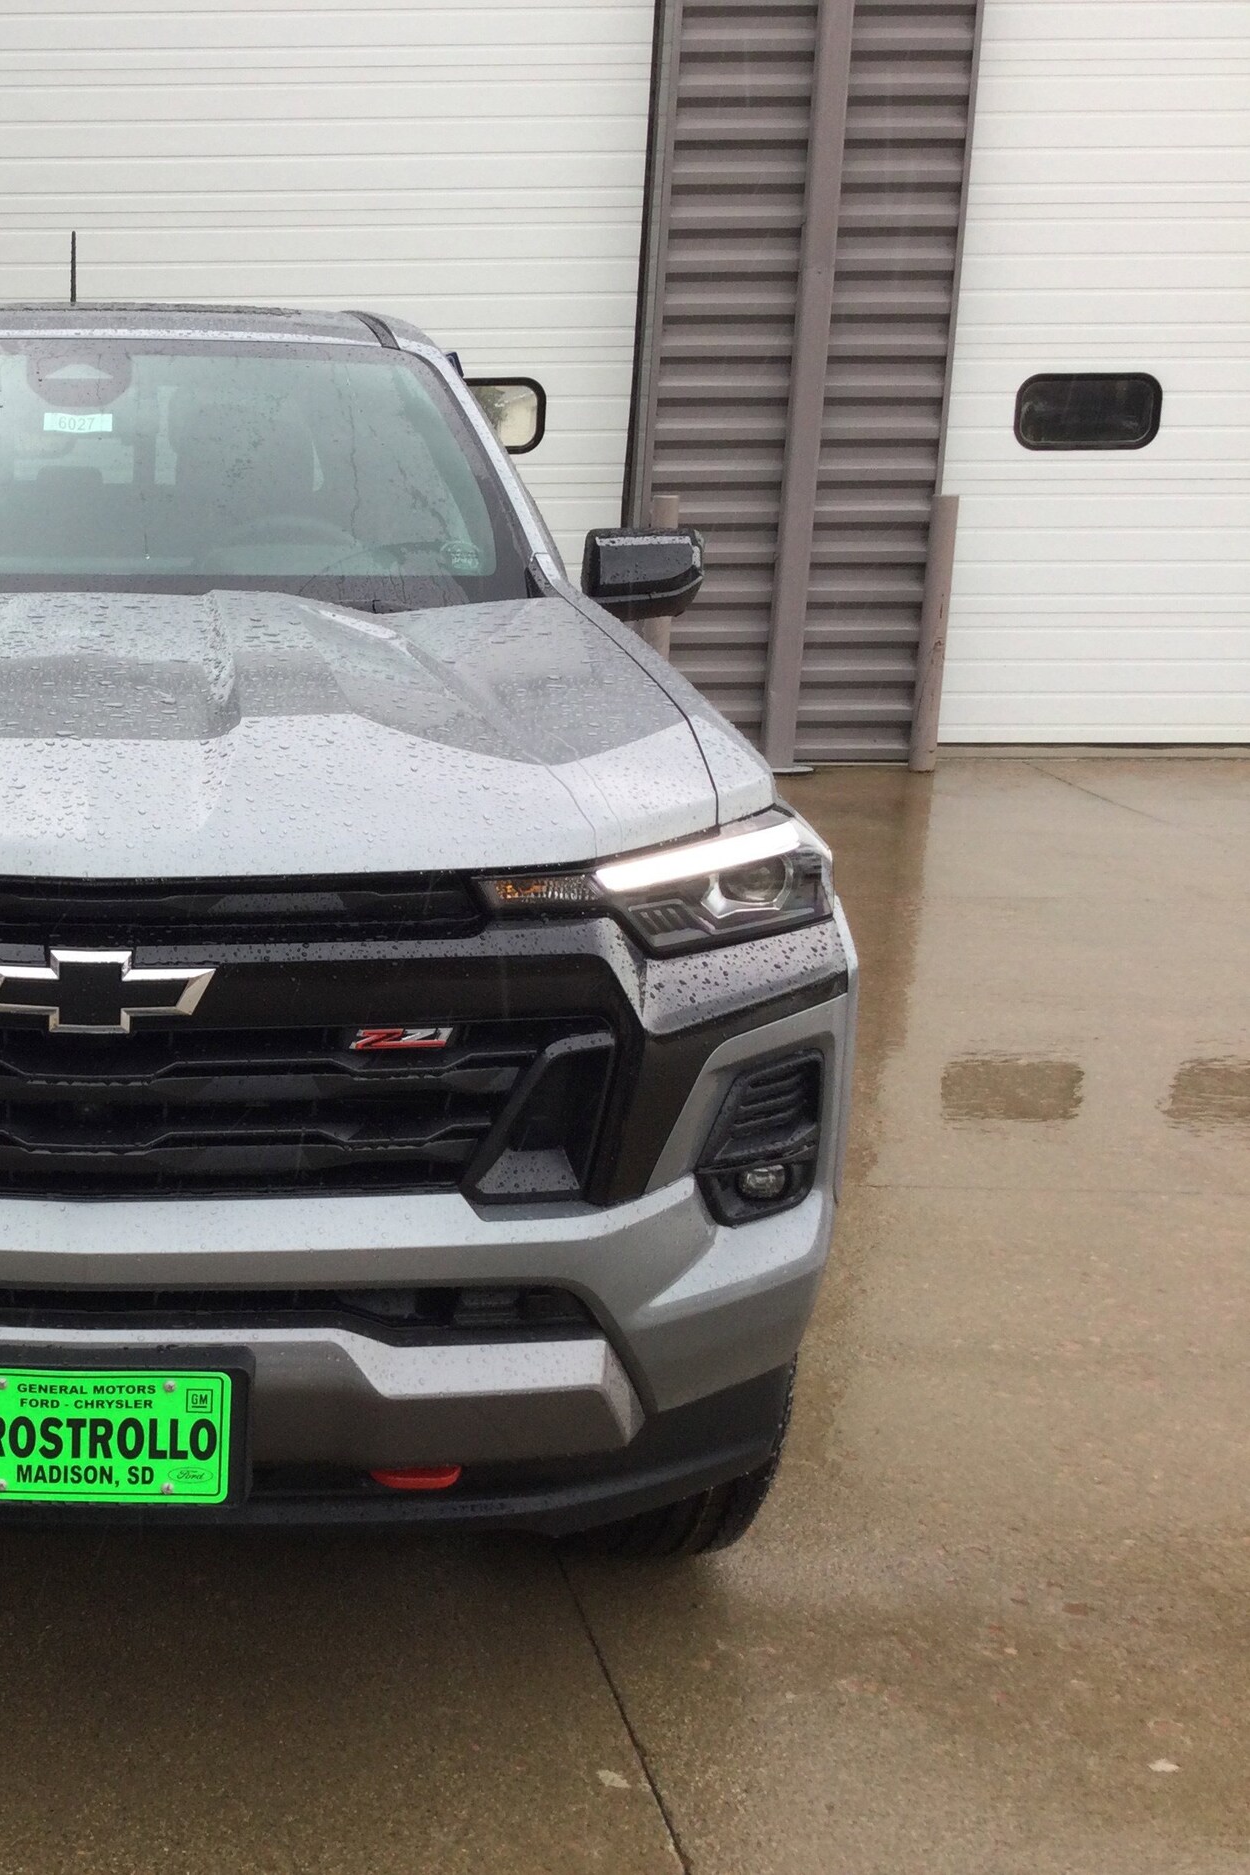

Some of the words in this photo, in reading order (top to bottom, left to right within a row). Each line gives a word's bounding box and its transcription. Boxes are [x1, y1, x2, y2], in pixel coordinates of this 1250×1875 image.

[58, 416, 95, 430] 6027
[349, 1027, 453, 1049] Z71
[17, 1383, 88, 1395] GENERAL
[93, 1384, 157, 1395] MOTORS
[20, 1398, 60, 1409] FORD
[73, 1399, 154, 1409] CHRYSLER
[190, 1393, 209, 1405] GM
[16, 1464, 120, 1487] MADISON,
[127, 1466, 154, 1485] SD
[176, 1470, 205, 1480] Ford
